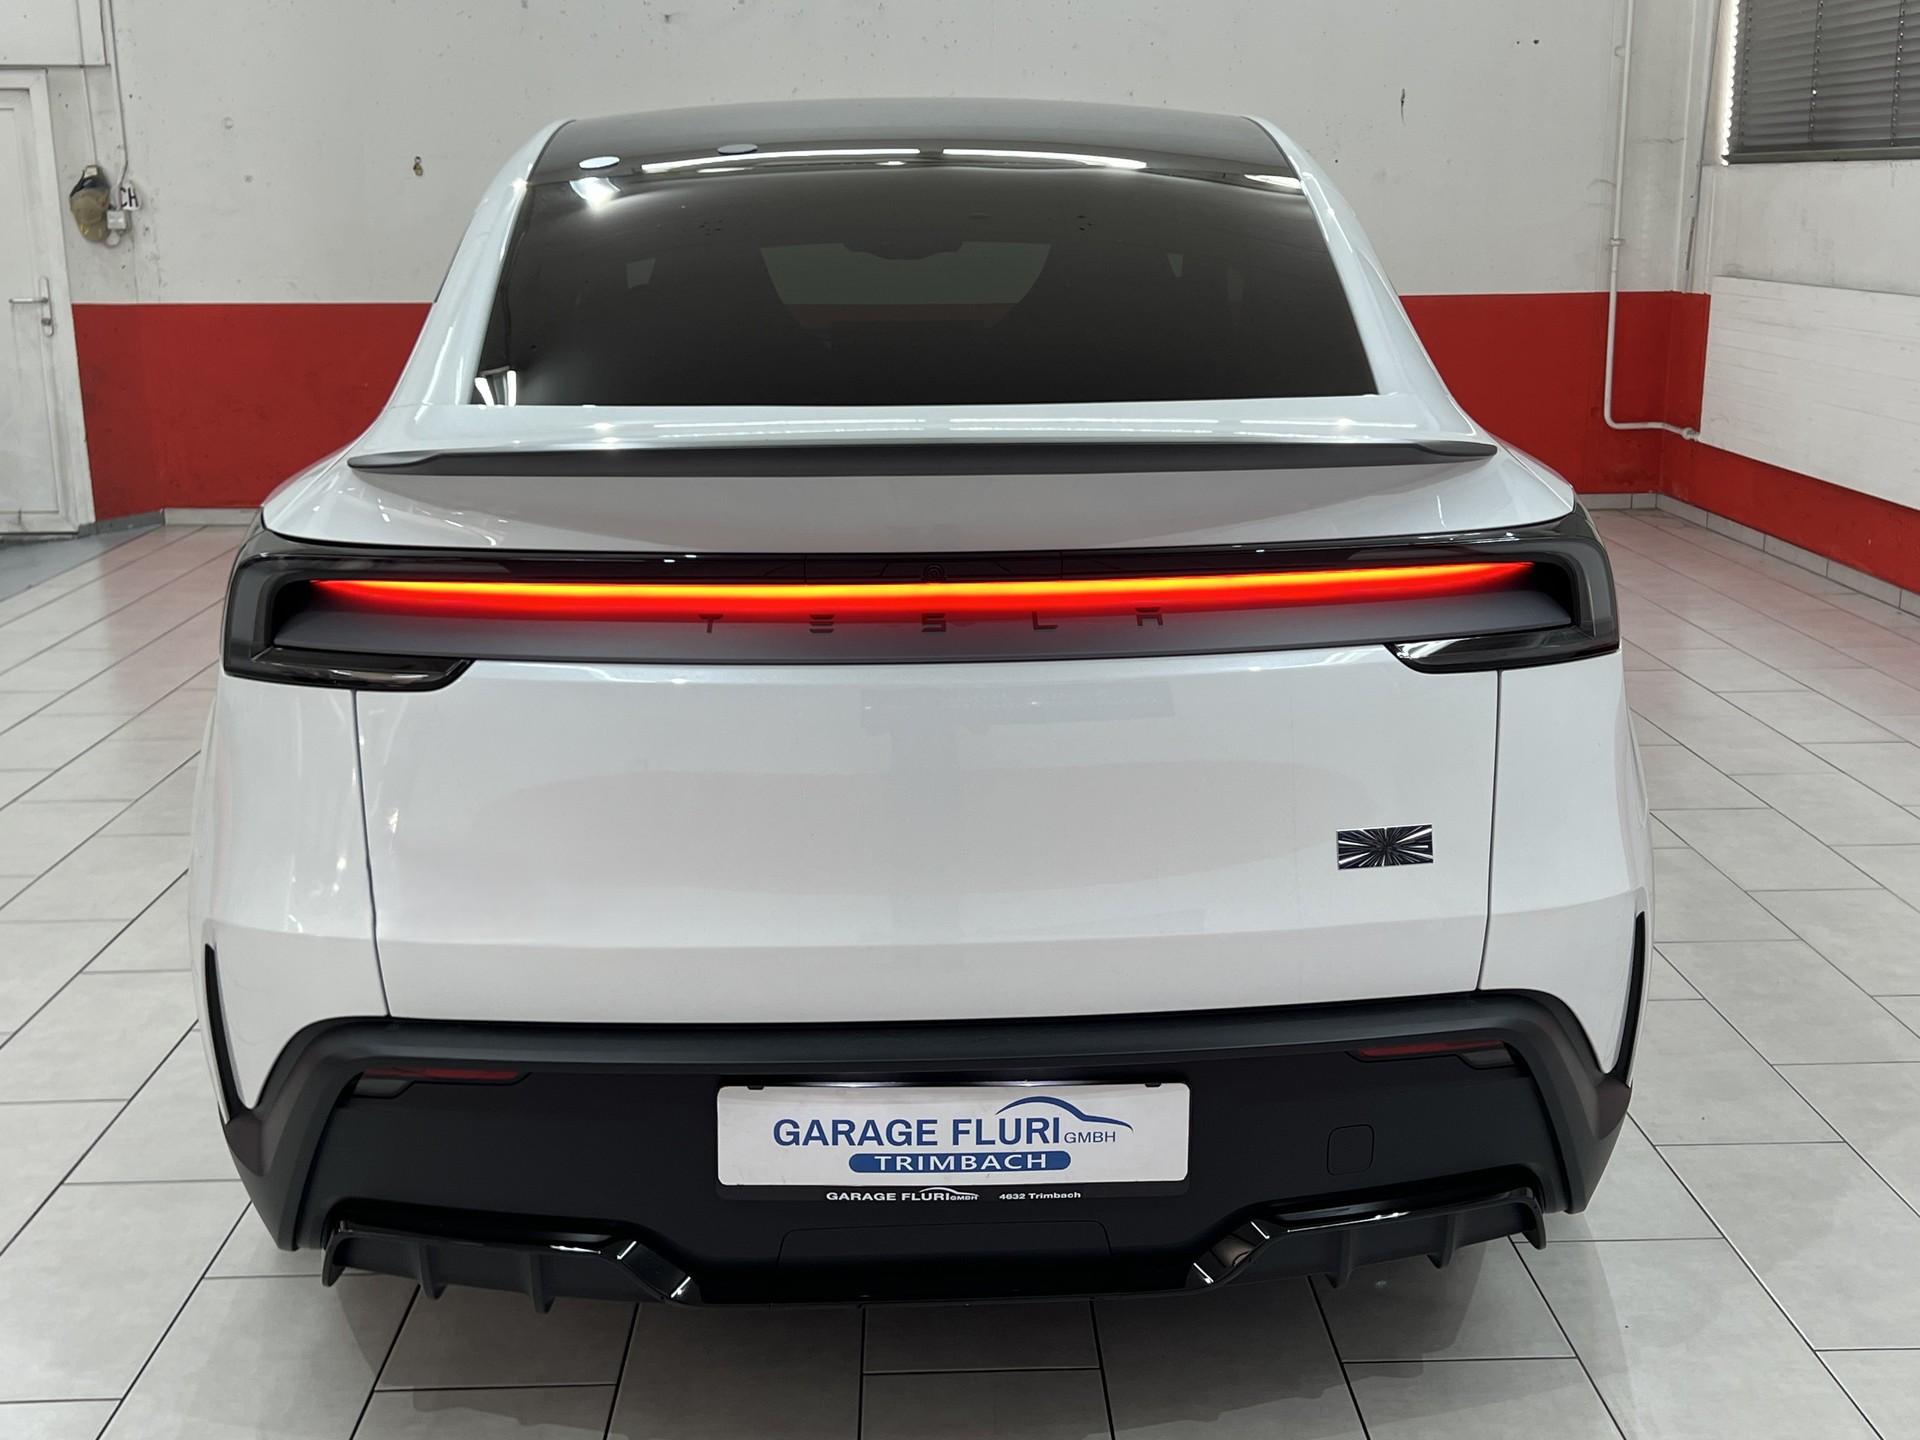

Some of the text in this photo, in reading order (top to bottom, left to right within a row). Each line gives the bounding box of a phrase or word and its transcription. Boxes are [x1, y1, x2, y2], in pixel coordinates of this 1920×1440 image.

[698, 607, 1164, 634] TESLA
[773, 1116, 1116, 1147] GARAGE FLURI GMBH
[874, 1153, 1047, 1171] TRIMBACH
[826, 1191, 897, 1201] GARAGE
[901, 1191, 950, 1201] FLURI
[999, 1192, 1026, 1200] 4632
[1028, 1190, 1082, 1200] Trimbach
